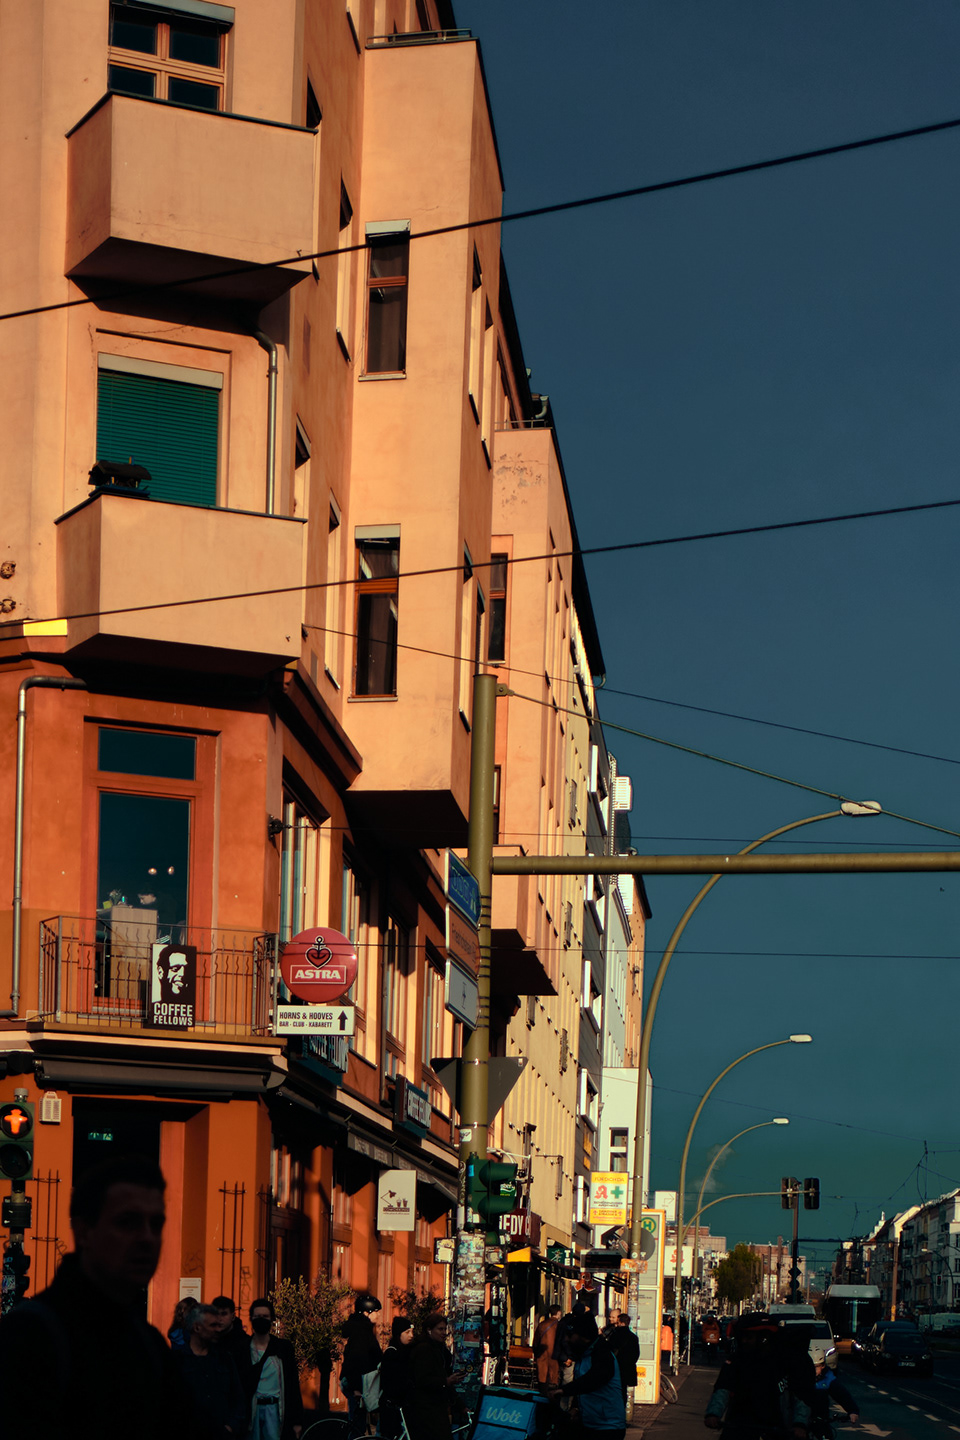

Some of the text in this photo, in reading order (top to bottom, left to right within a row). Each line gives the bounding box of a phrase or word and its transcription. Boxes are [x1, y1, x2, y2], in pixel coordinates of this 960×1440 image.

[295, 970, 340, 979] ASTRA
[154, 1003, 192, 1016] COFFEE
[154, 1015, 192, 1026] FELLOWS
[486, 1407, 522, 1424] Wolt
